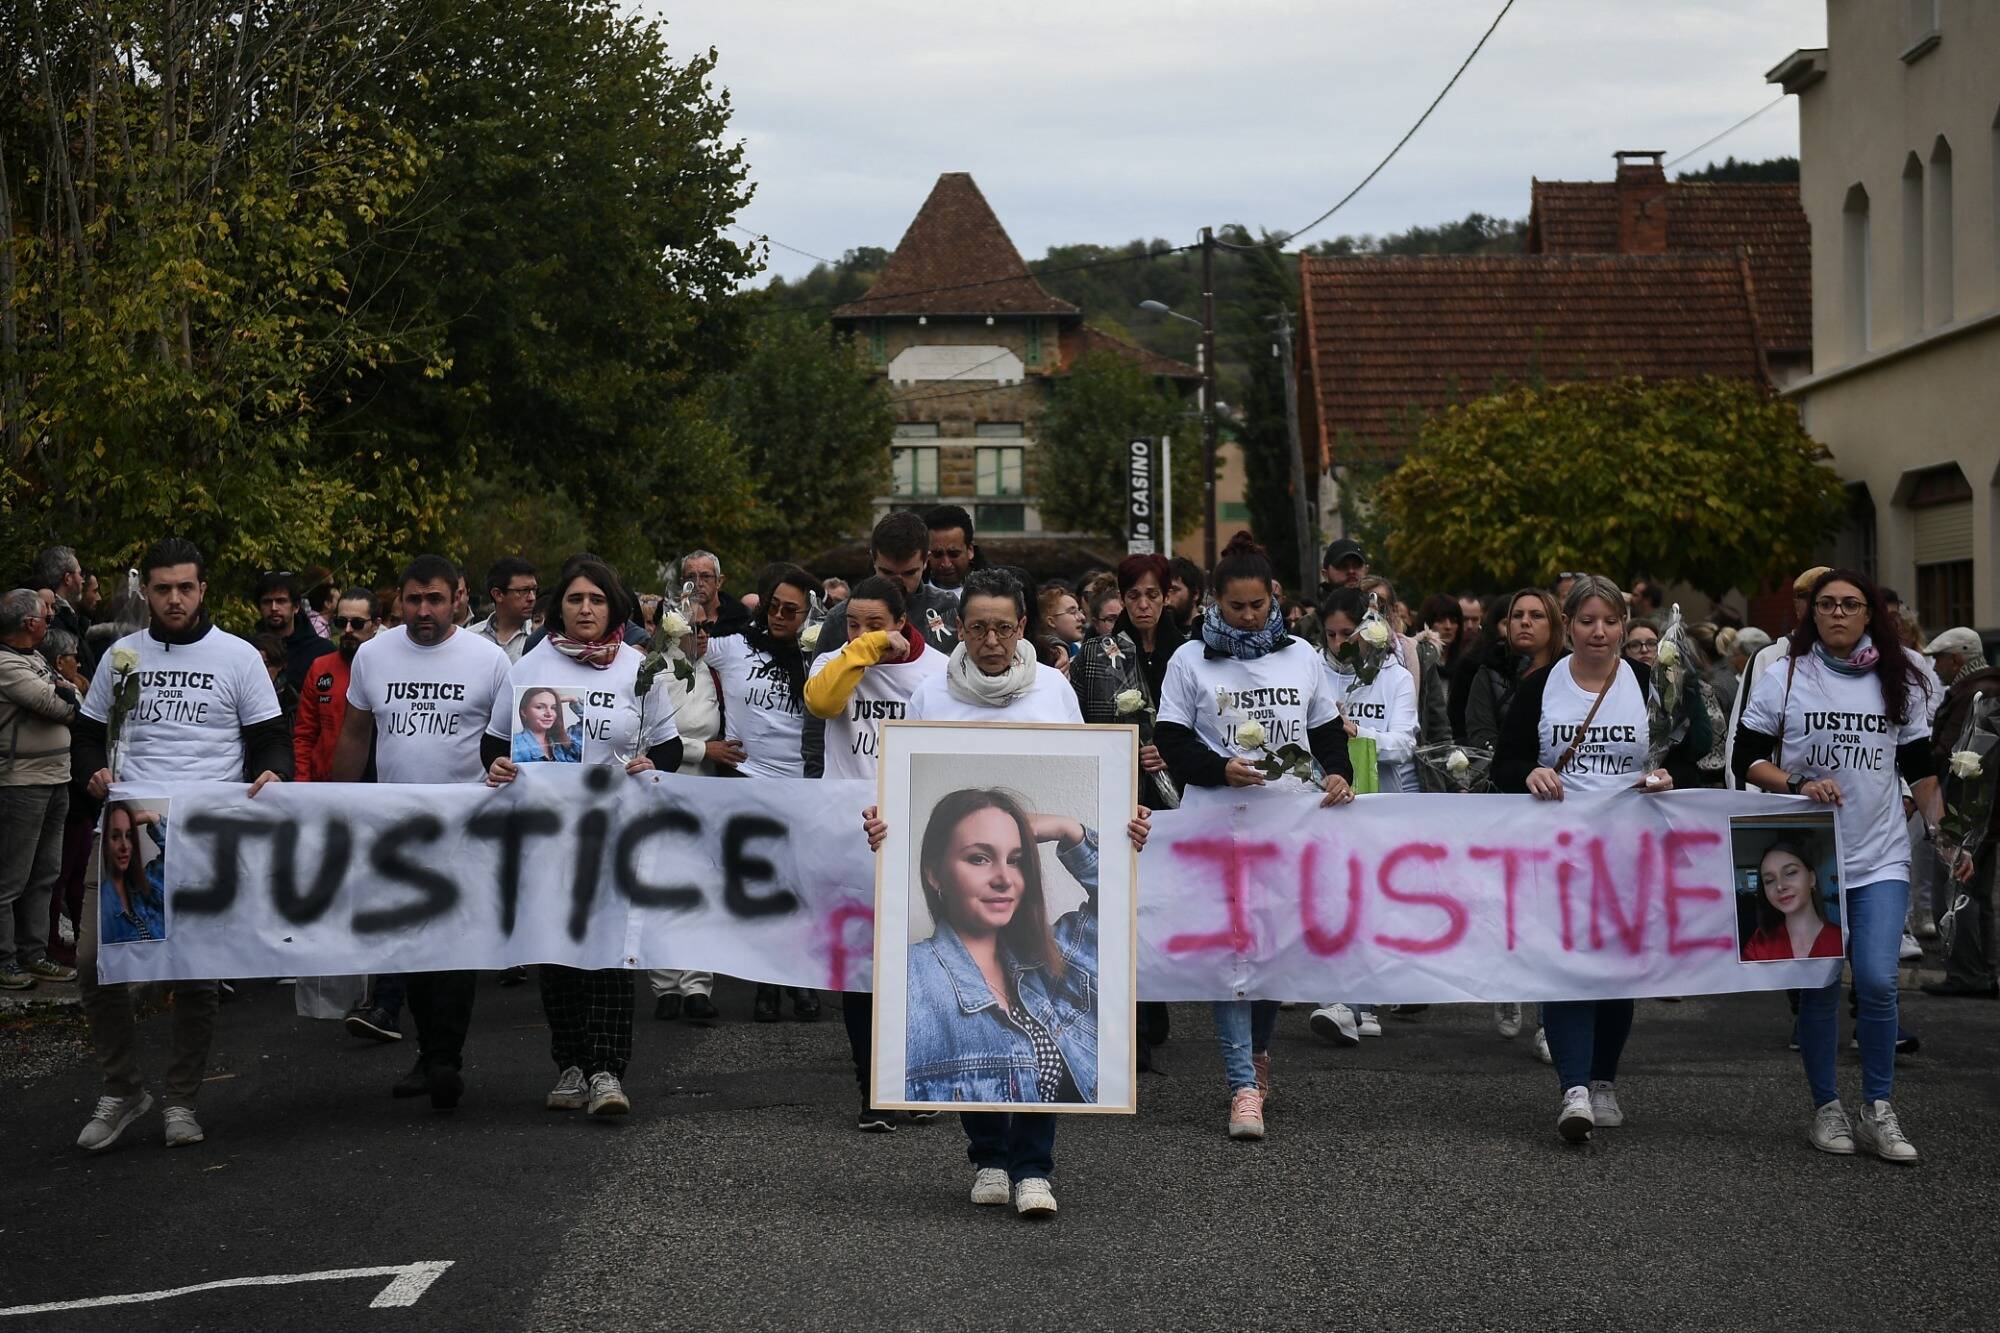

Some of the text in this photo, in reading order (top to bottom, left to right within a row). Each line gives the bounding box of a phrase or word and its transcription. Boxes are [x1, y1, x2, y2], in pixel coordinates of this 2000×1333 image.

[1131, 441, 1149, 517] CASINO
[141, 671, 214, 690] USTICE
[157, 689, 183, 698] POUR
[385, 682, 465, 704] JUSTICE
[745, 688, 803, 715] JUSTIN
[411, 702, 436, 710] POUR
[852, 700, 906, 721] JUSTI
[1248, 709, 1275, 720] POUR
[1349, 702, 1385, 719] TICE
[388, 712, 460, 736] JUSTINE
[1804, 712, 1888, 735] JUSTICE
[1579, 744, 1605, 753] POUR
[1833, 734, 1860, 743] POUR
[1806, 744, 1883, 770] JUSTINE
